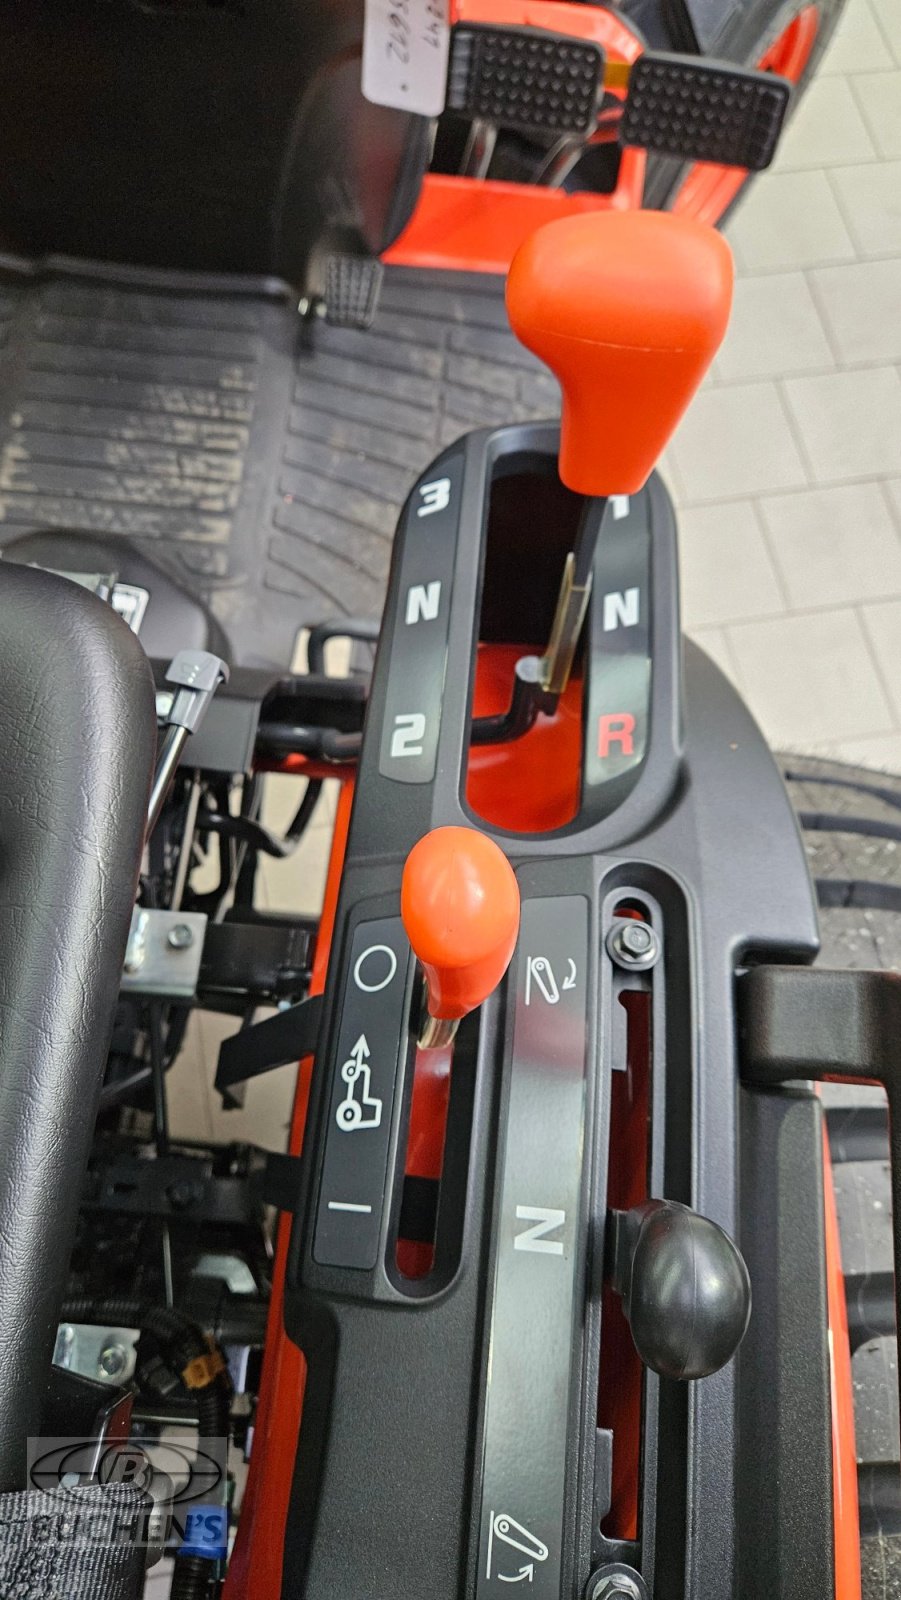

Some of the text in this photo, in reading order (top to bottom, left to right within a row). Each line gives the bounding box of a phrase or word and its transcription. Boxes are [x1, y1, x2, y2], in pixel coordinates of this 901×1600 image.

[417, 477, 451, 518] 3
[405, 580, 442, 625] N
[603, 587, 640, 632] N
[391, 713, 426, 758] 2
[597, 713, 636, 758] R
[514, 1205, 566, 1256] N
